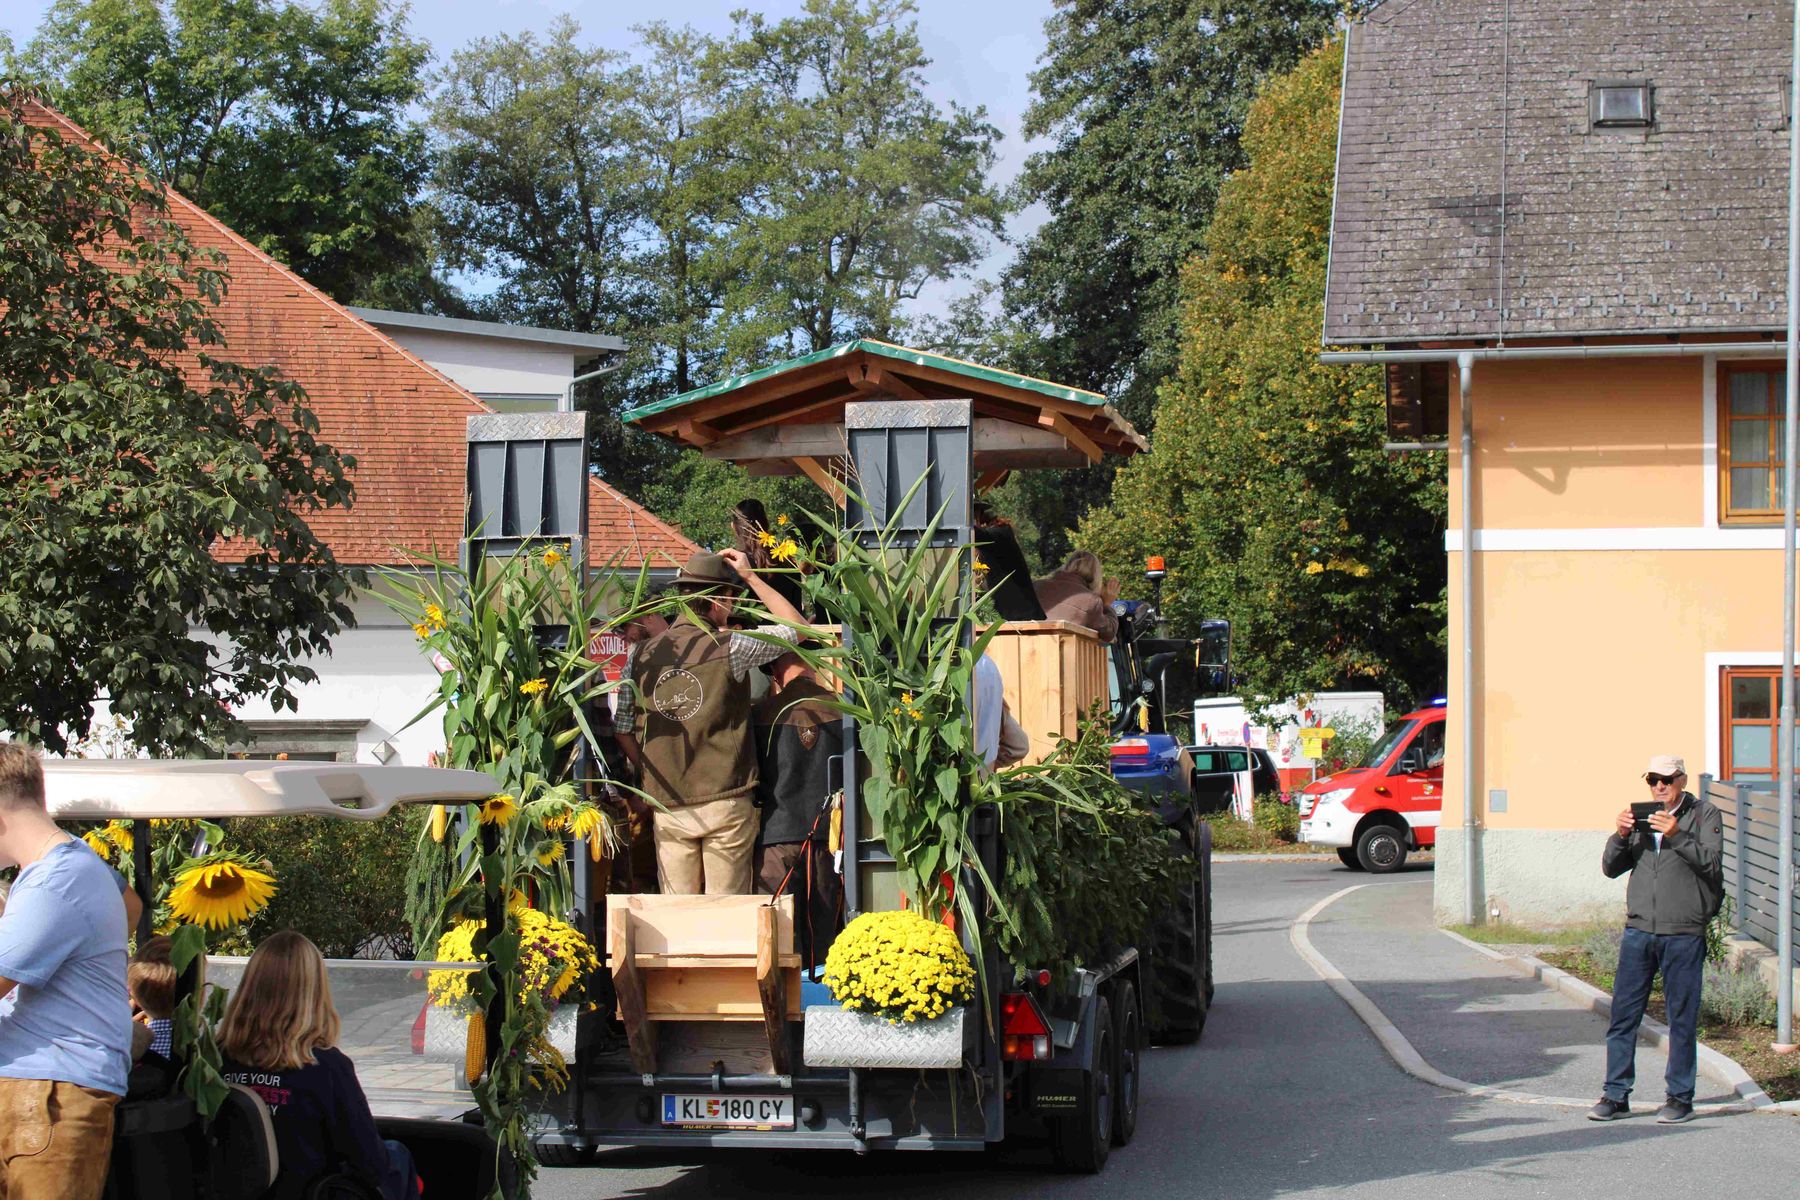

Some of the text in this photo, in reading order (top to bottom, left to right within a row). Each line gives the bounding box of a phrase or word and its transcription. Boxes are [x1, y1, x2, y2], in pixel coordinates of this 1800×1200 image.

[223, 1073, 281, 1087] GIVE YOUR
[682, 1098, 784, 1120] KL 180 CY
